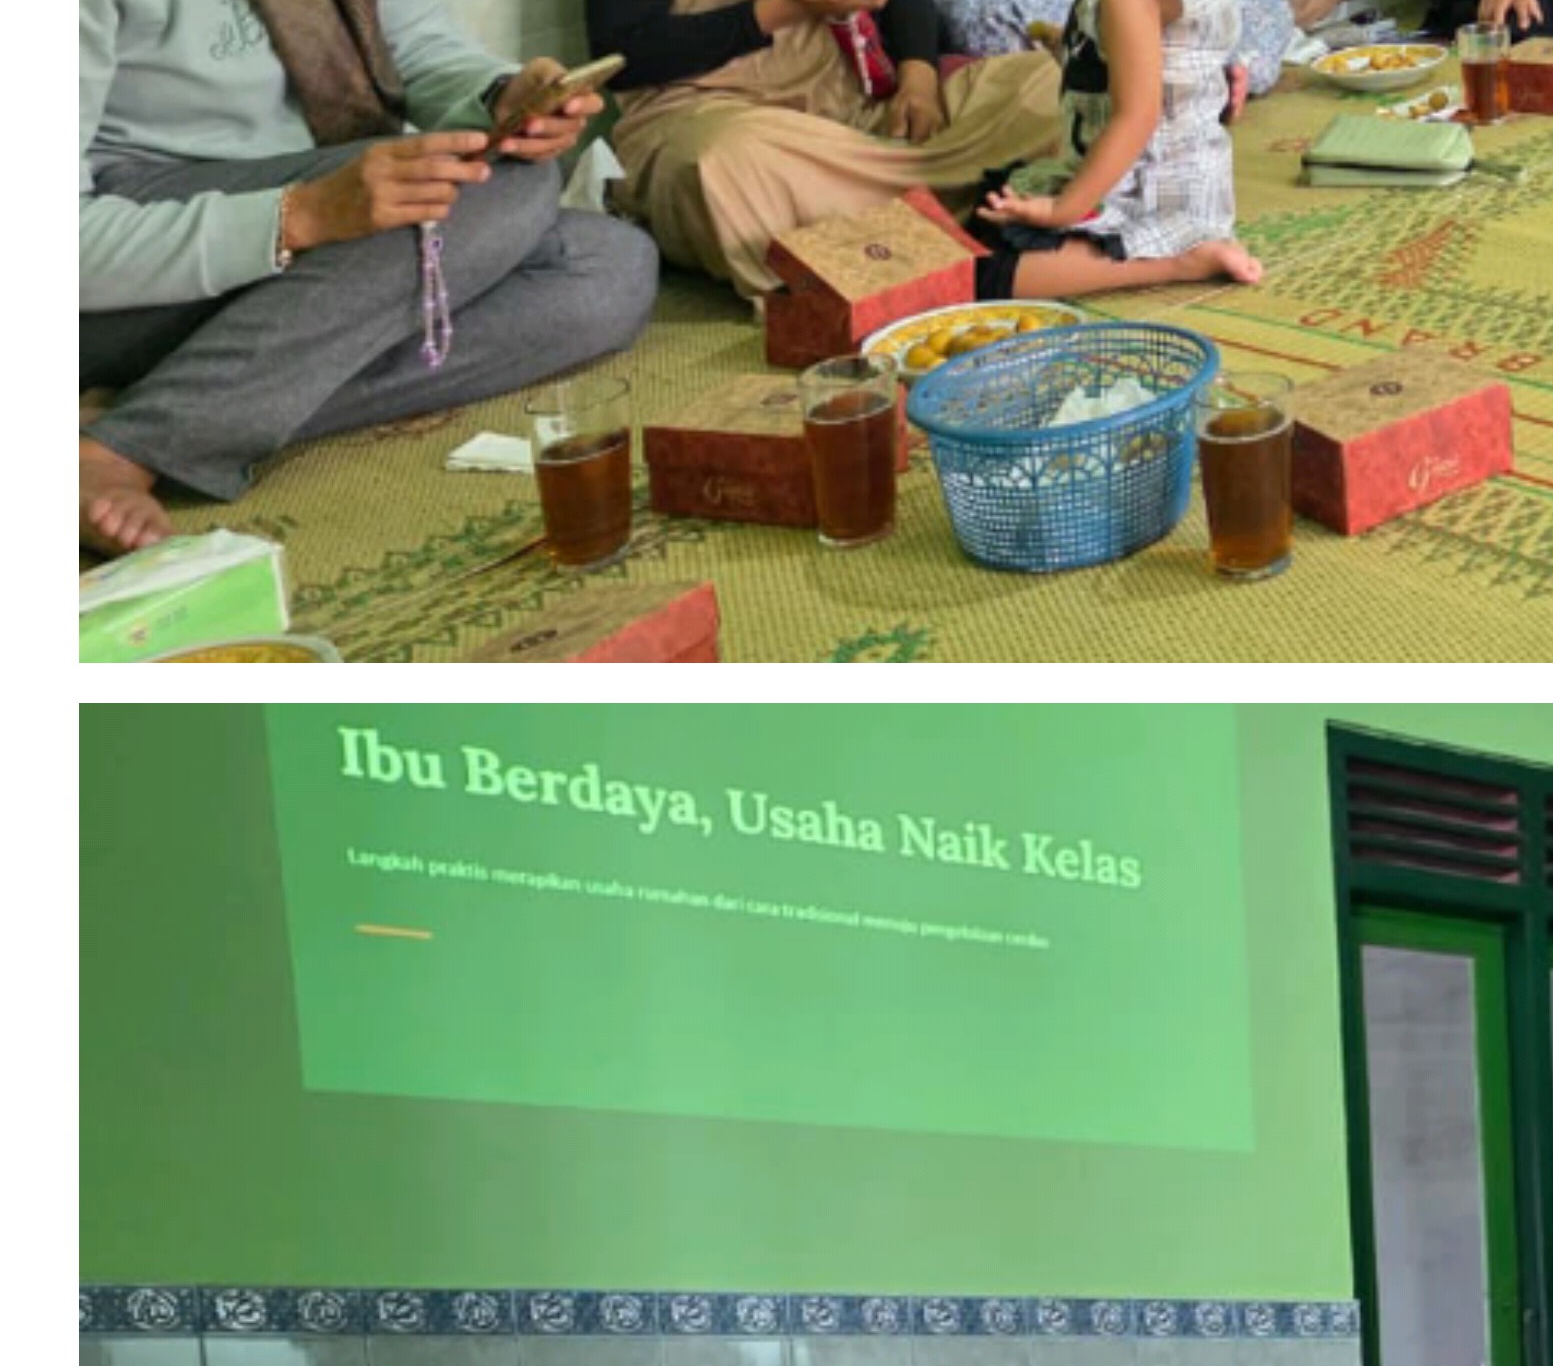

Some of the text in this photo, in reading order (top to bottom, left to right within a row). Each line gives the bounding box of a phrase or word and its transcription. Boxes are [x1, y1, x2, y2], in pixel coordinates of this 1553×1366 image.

[337, 726, 1142, 888] Ibu Berdaya, Usaha Naik Kelas
[346, 847, 424, 873] Langkah
[428, 860, 489, 879] praktis
[585, 879, 633, 898] usaha
